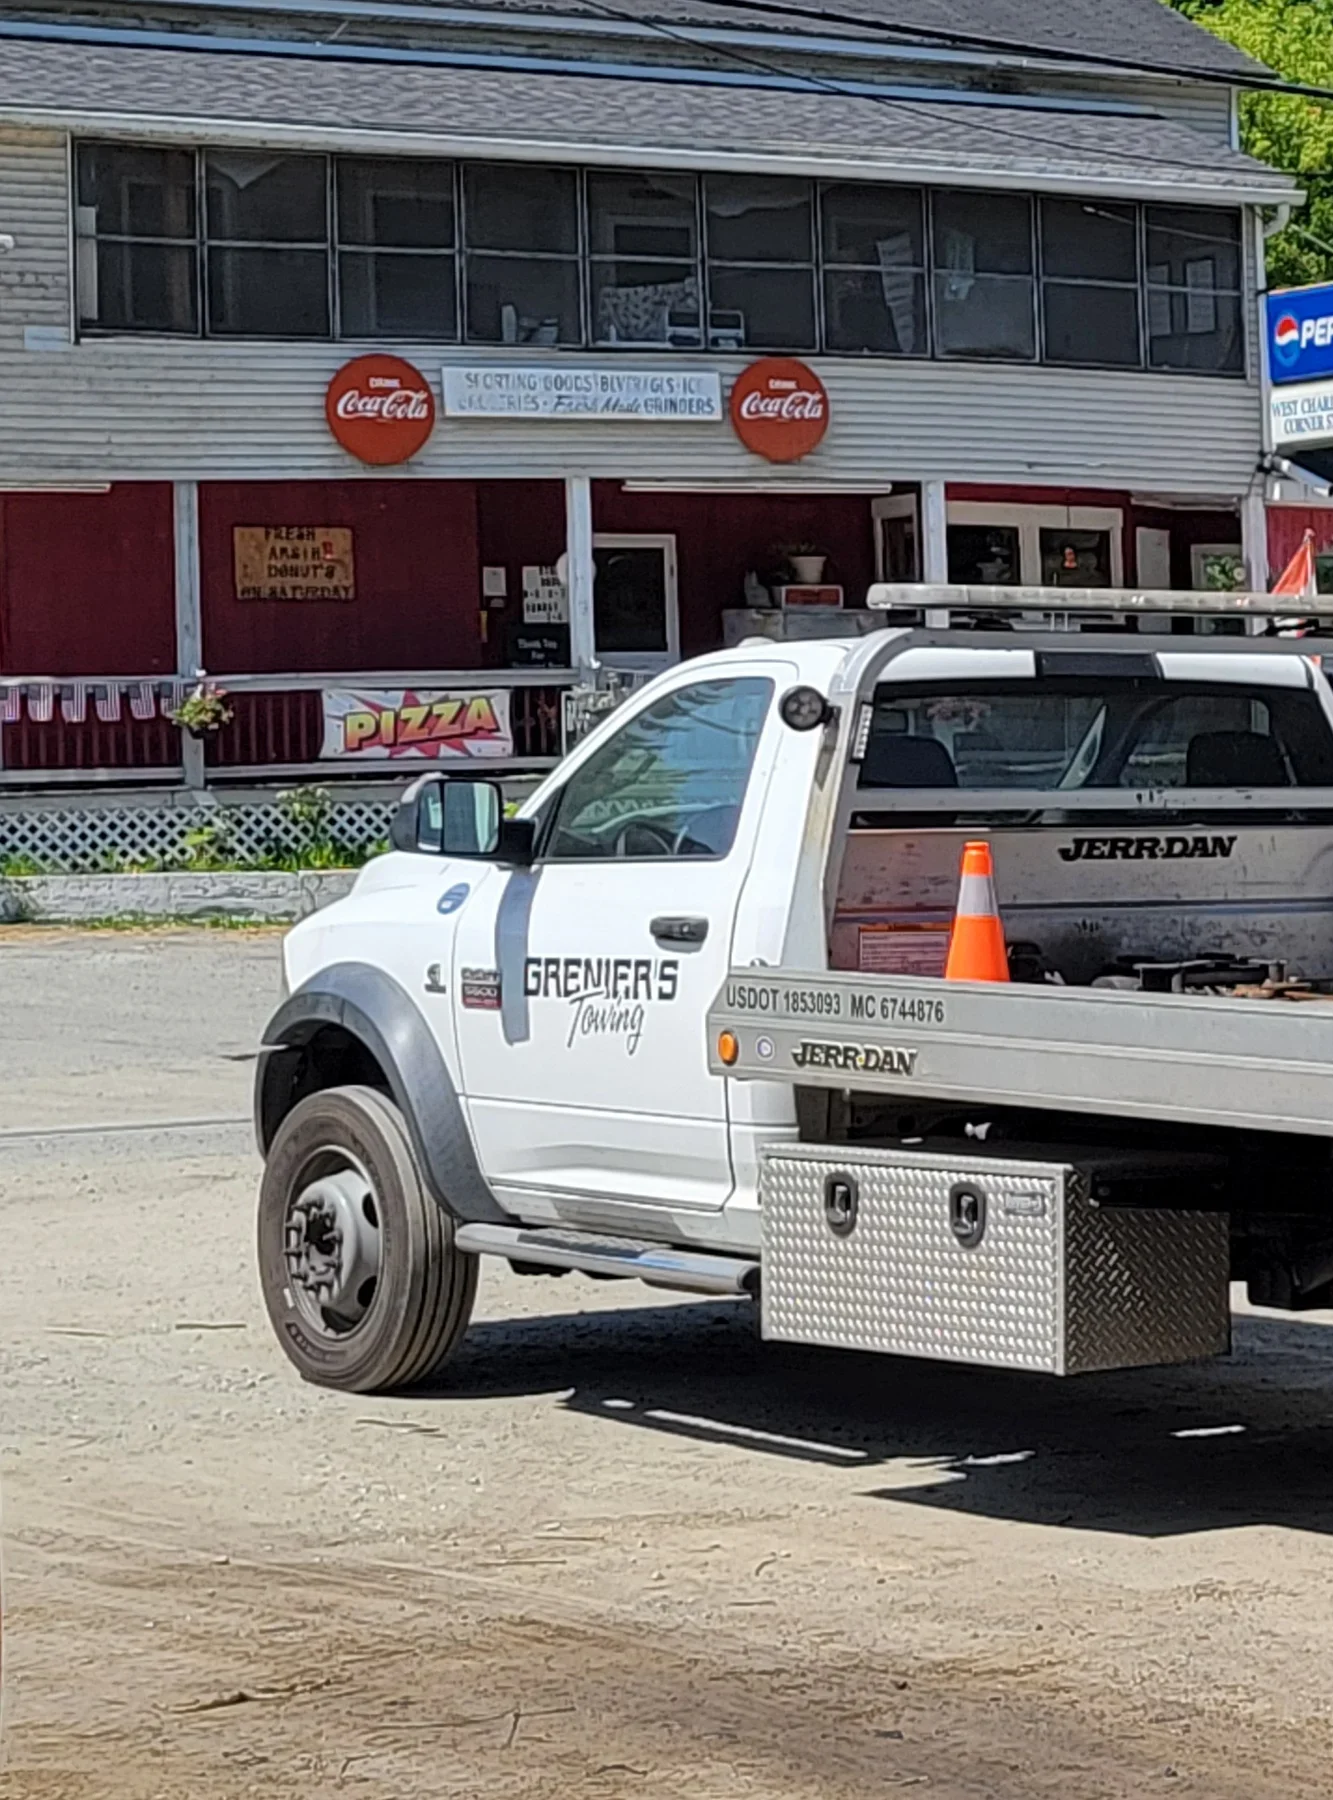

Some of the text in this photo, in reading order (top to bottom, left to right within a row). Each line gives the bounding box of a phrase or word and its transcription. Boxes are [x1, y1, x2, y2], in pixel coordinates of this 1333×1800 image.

[337, 389, 428, 420] Coca-Cola
[741, 391, 823, 419] Coca-Cola
[1272, 398, 1299, 418] WEST
[344, 696, 500, 752] PIZZA
[524, 957, 679, 1000] GRENIER'S
[727, 984, 945, 1023] USDOT 1853093 MC 6744876
[566, 991, 645, 1056] Towing
